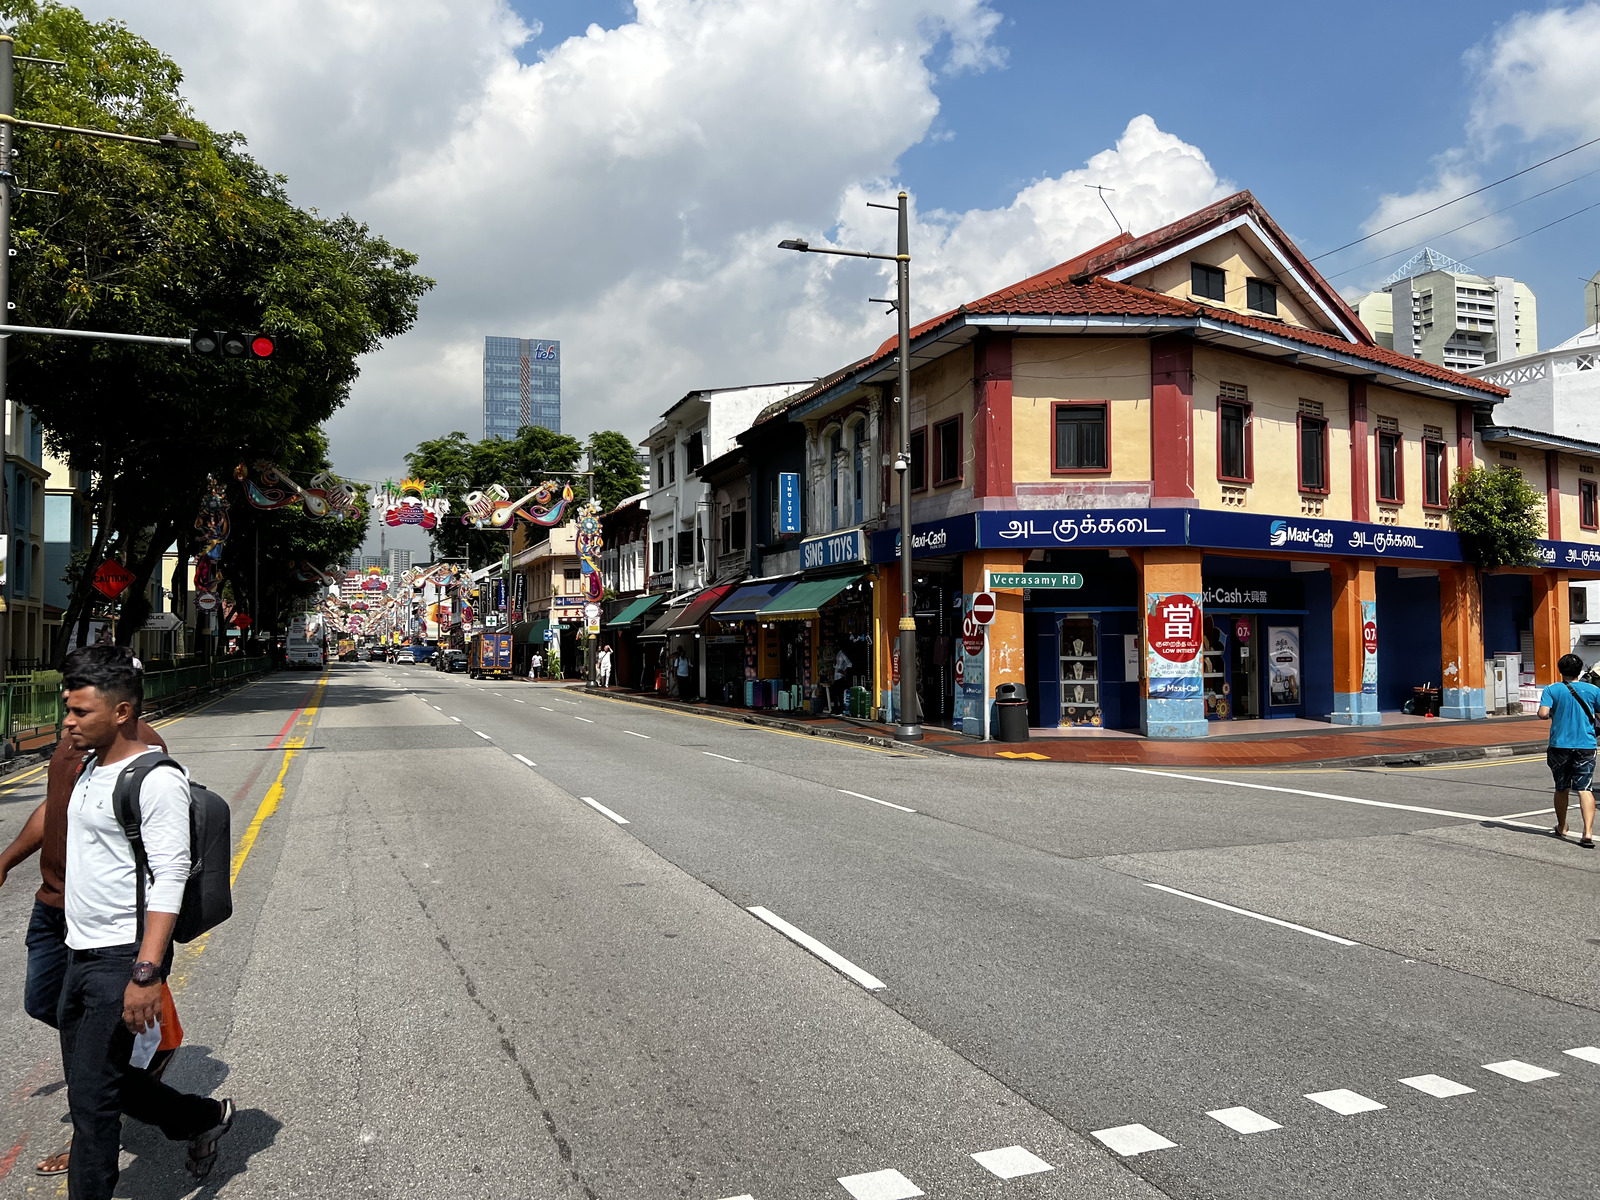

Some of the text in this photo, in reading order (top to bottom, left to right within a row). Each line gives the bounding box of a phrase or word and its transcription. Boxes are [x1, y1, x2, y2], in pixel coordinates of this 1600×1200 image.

[998, 513, 1167, 542] அடகுக்கடை
[1287, 526, 1334, 544] Maxi-Cash
[828, 535, 853, 563] TOYS
[1348, 529, 1424, 553] அடகுக்கடை
[93, 574, 129, 583] CAUTION
[993, 574, 1076, 587] Veerasamy Rd
[516, 575, 524, 609] ARTISTIC
[1202, 587, 1242, 604] xi-Cash
[1163, 603, 1194, 639] 當
[1166, 684, 1200, 692] Maxi-Cash
